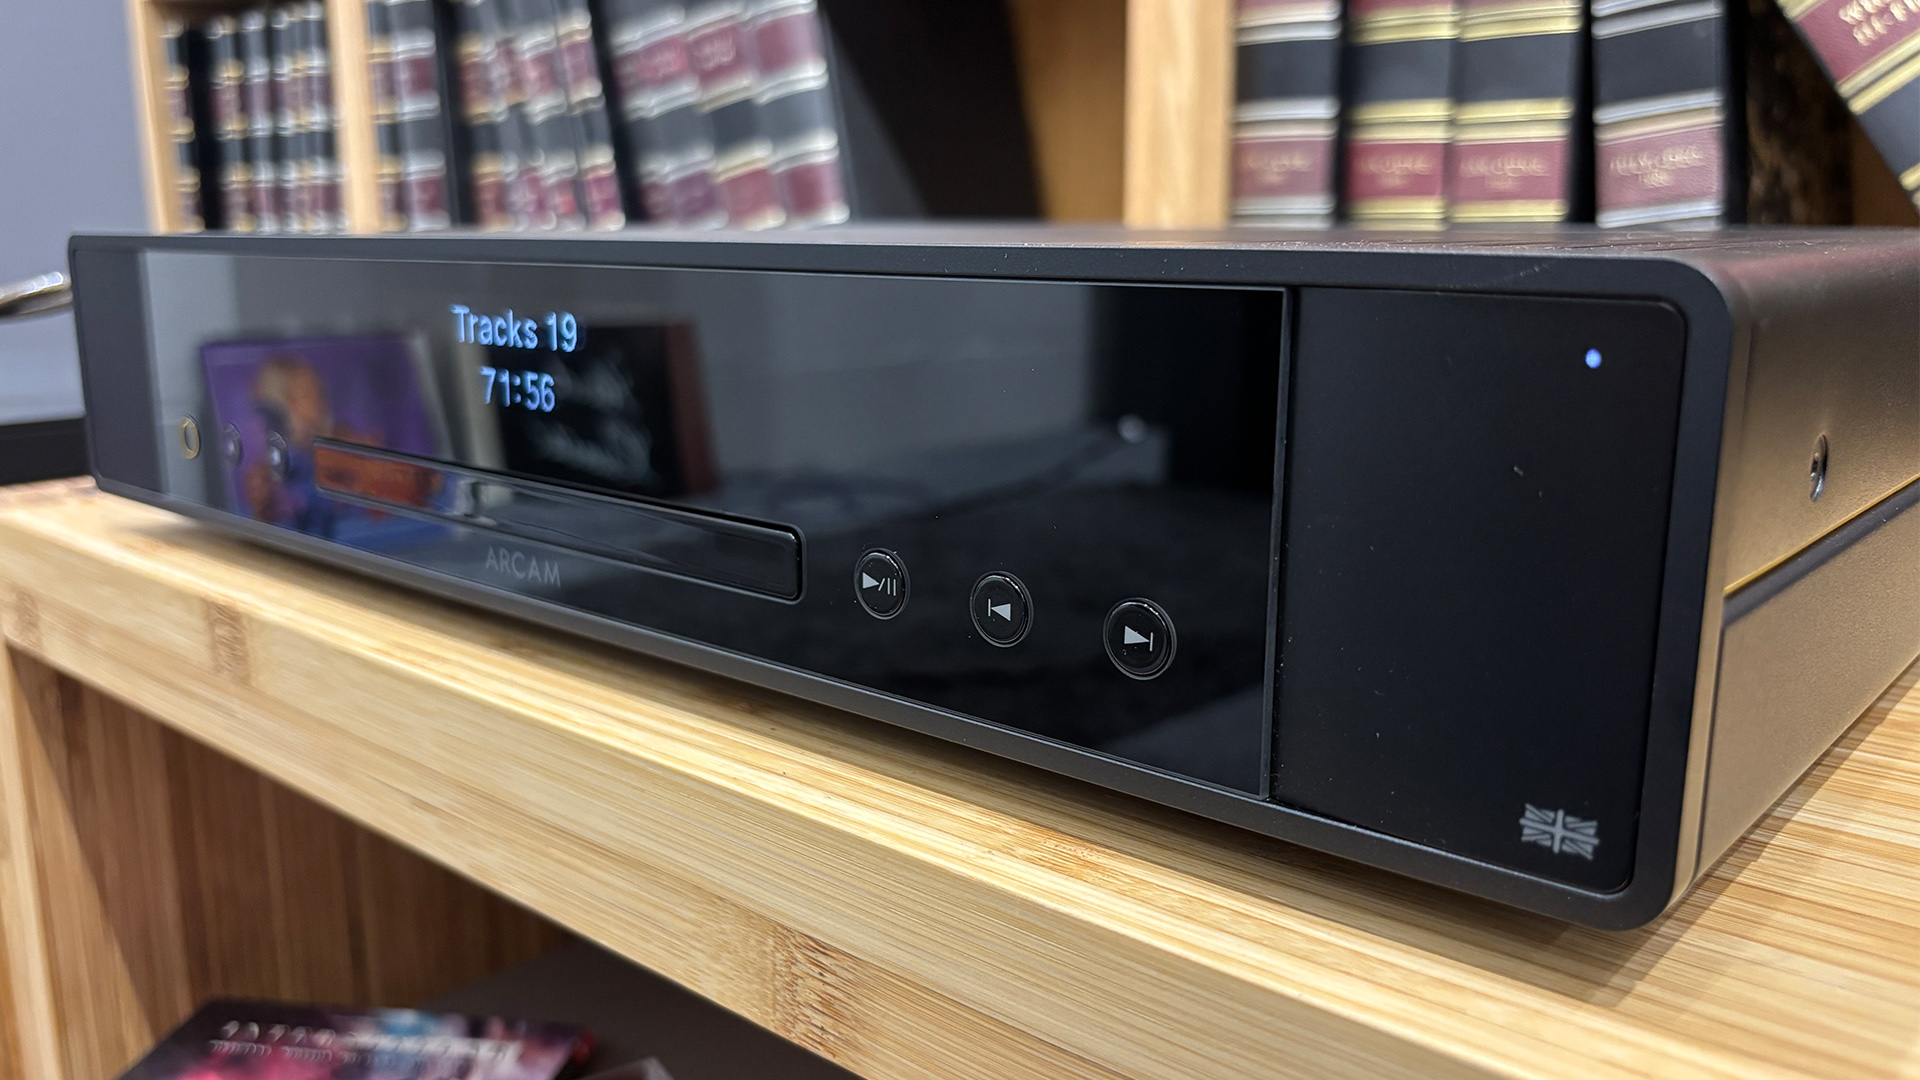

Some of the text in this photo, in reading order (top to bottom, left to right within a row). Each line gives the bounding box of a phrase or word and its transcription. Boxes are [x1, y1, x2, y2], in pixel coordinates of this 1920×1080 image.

[451, 304, 577, 352] Tracks 19
[479, 366, 555, 412] 71:56
[485, 546, 561, 588] ARCAM
